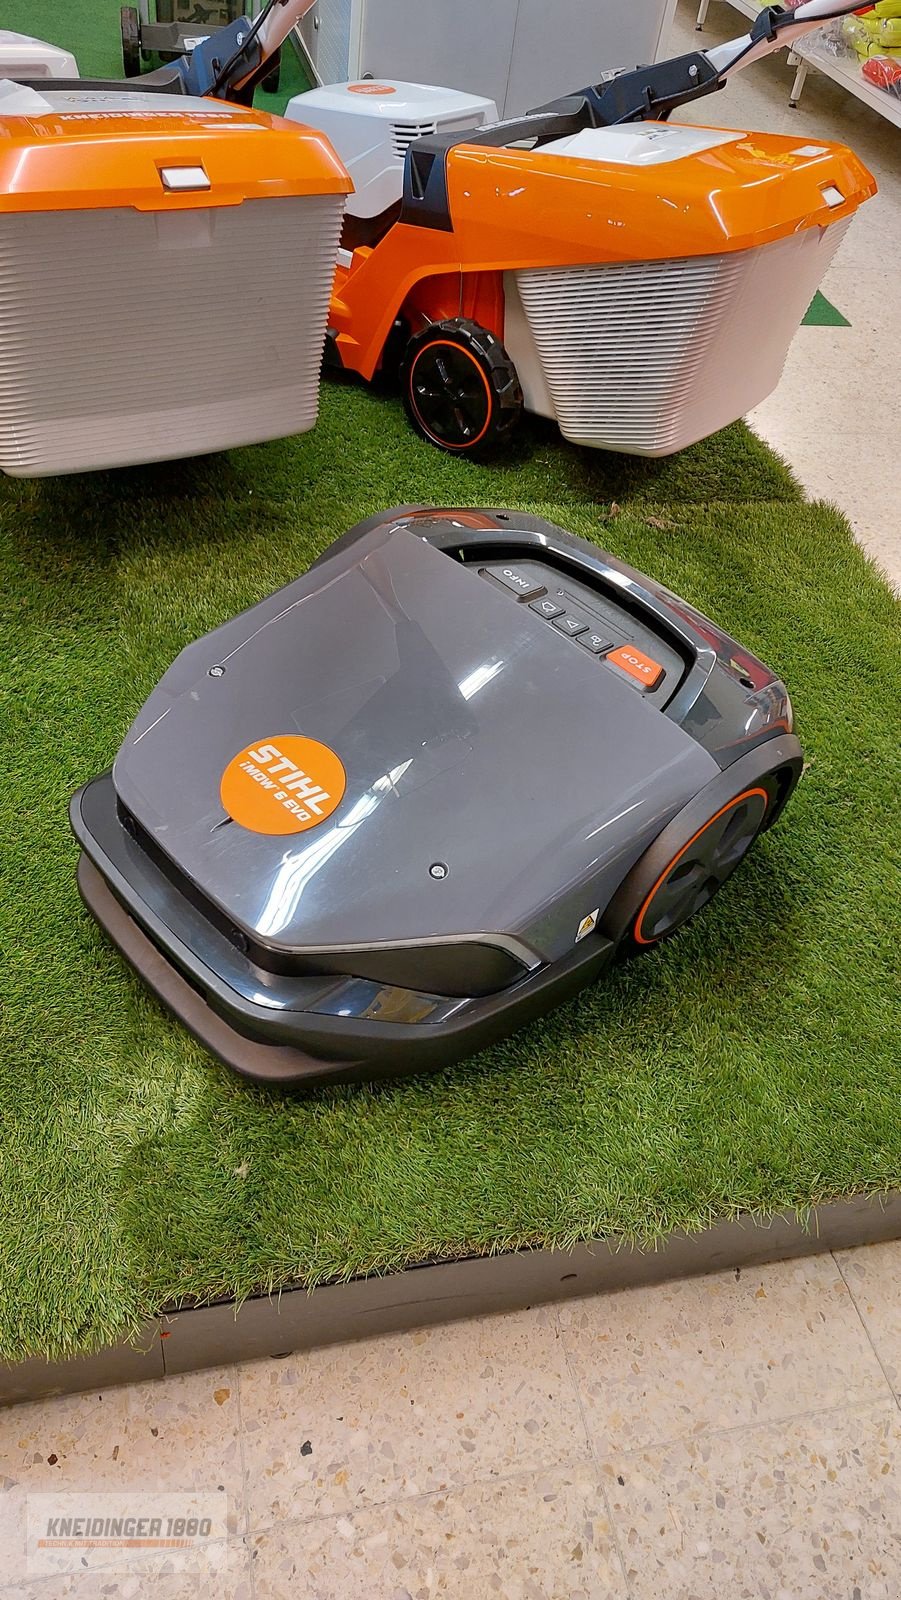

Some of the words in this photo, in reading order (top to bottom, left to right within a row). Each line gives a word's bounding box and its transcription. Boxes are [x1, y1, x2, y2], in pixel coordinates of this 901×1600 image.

[502, 569, 530, 588] INFO
[620, 652, 652, 674] STOP
[248, 744, 331, 816] STIHL
[273, 791, 288, 801] 6
[282, 799, 312, 822] EVO
